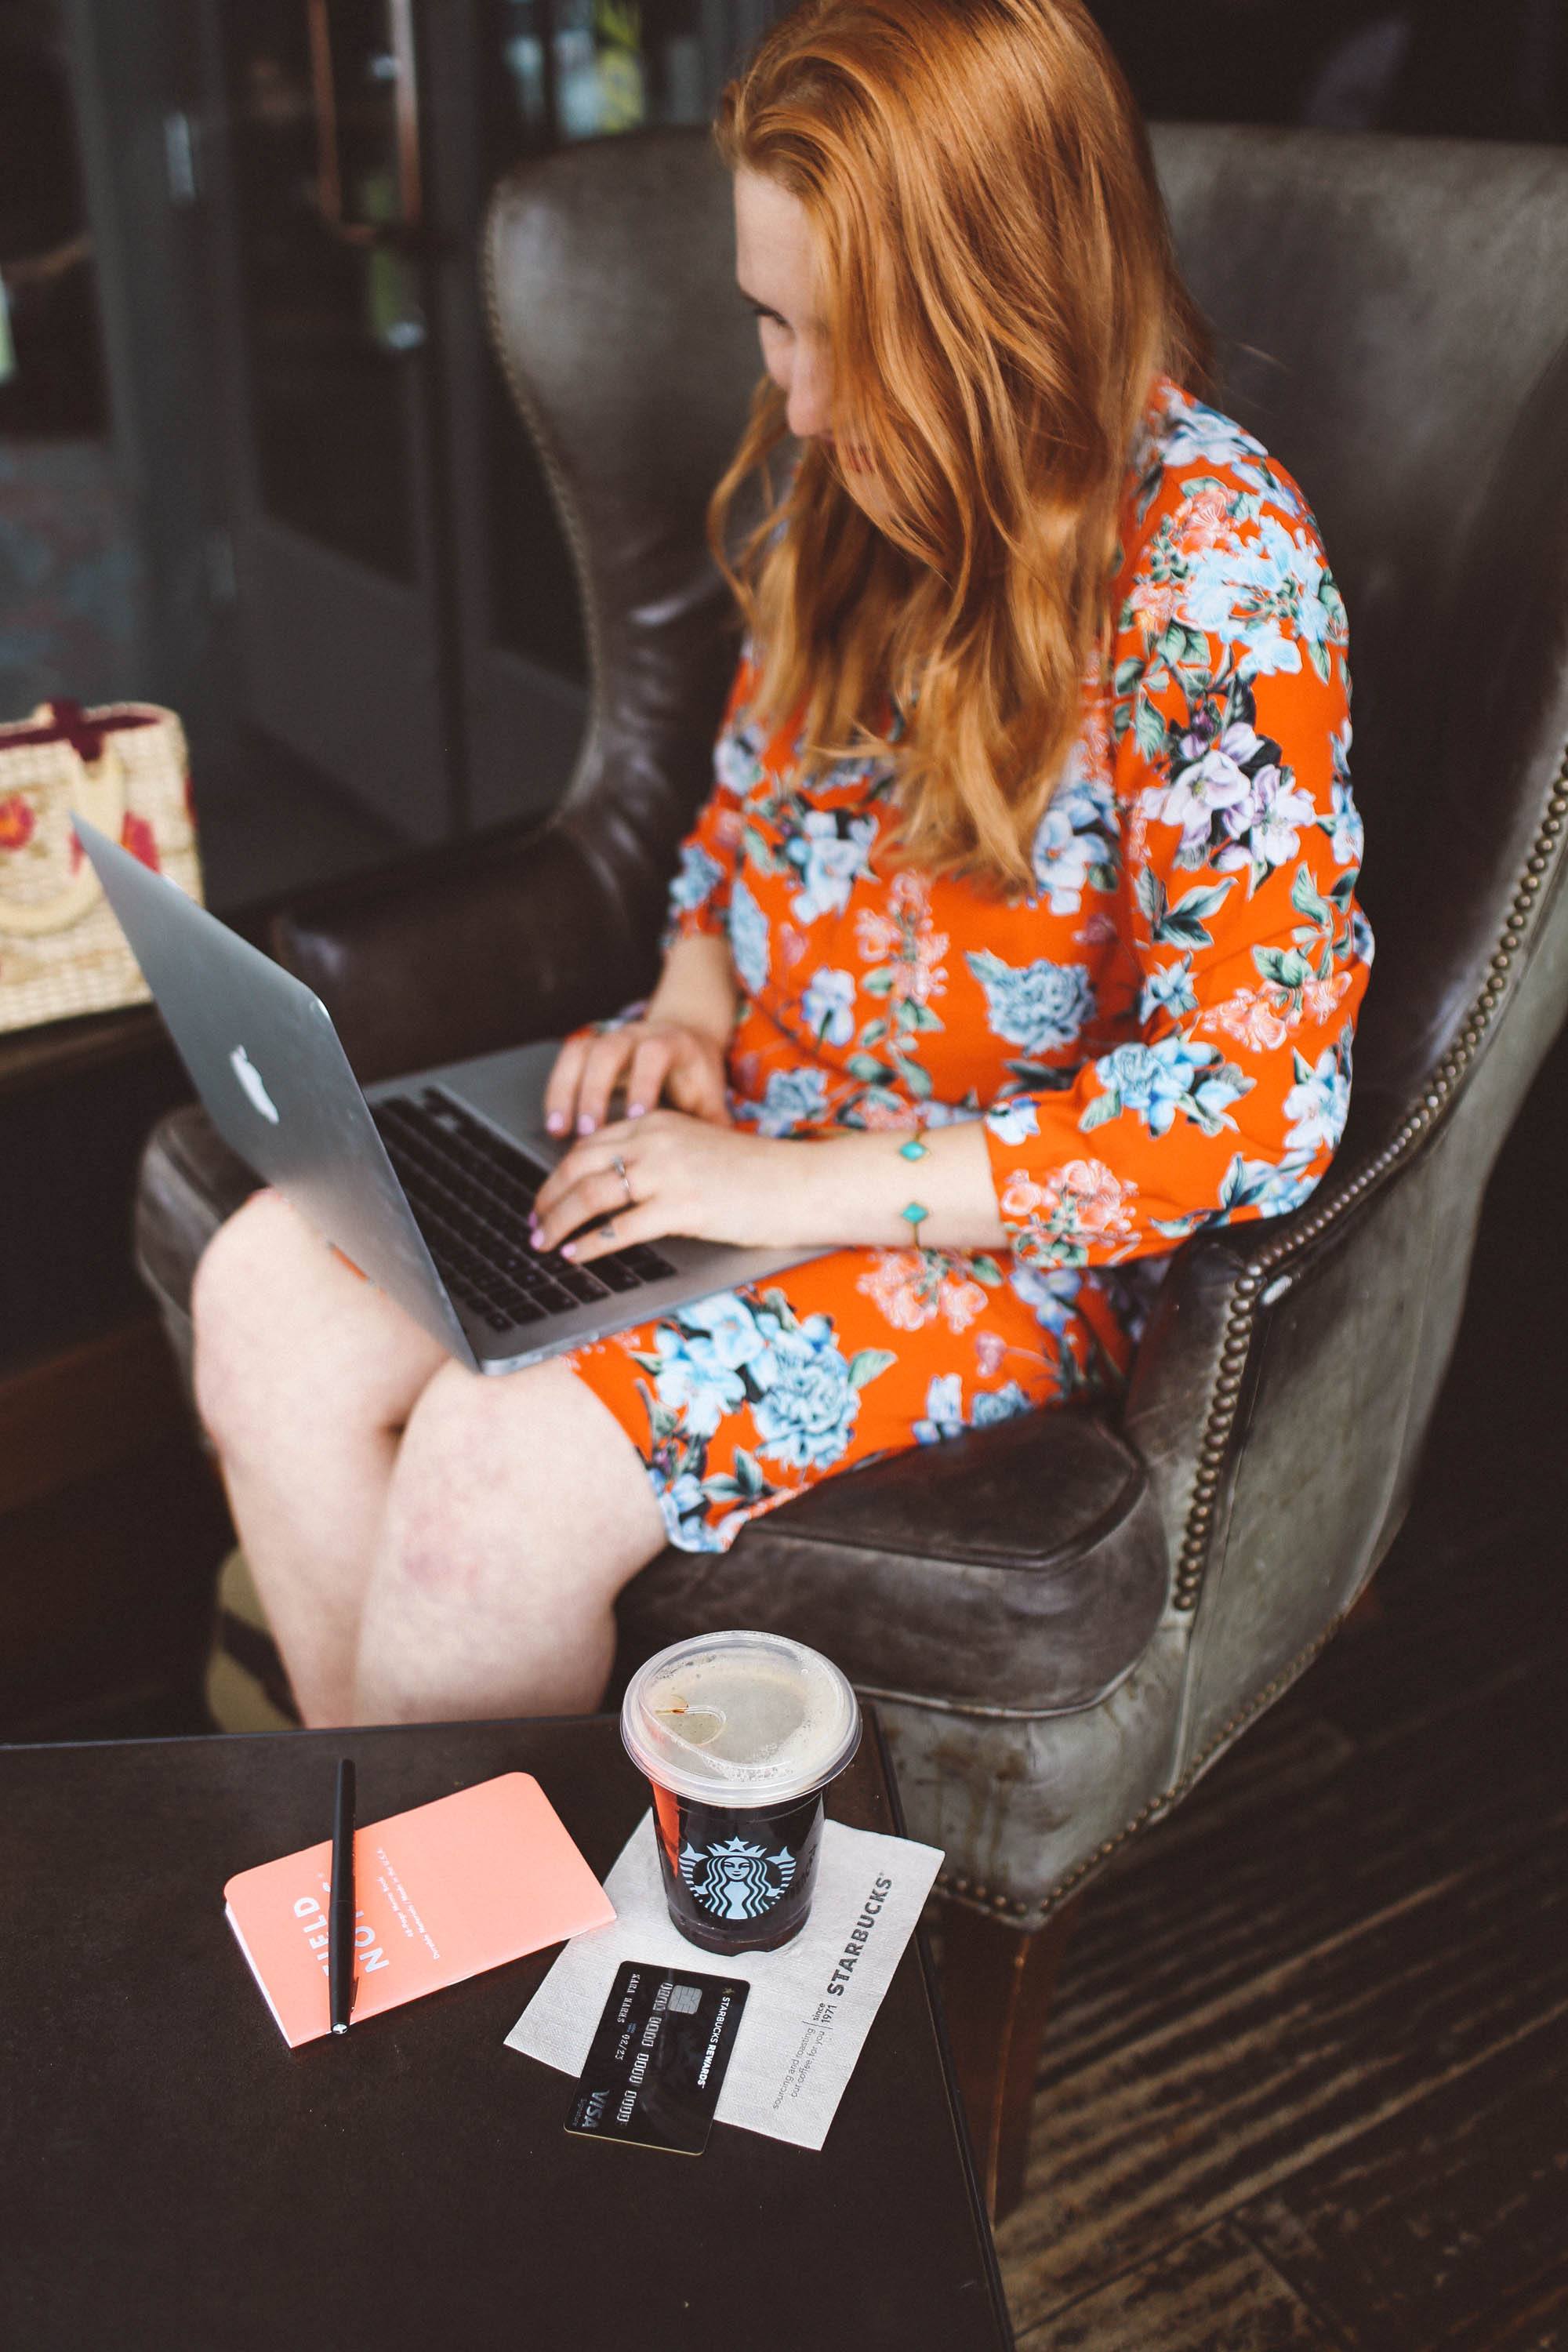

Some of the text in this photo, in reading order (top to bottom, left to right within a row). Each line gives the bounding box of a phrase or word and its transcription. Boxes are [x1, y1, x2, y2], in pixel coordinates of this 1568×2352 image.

[376, 1875, 390, 1893] Book
[396, 1883, 408, 1902] Made
[388, 1892, 399, 1911] Memo
[407, 1904, 426, 1934] Materials
[424, 1933, 440, 1960] Durable
[827, 1877, 893, 1997] STARBUCKS
[813, 2002, 826, 2021] since
[821, 2005, 837, 2024] 1971
[615, 2034, 630, 2061] 02/23
[697, 1996, 731, 2088] STARBUCKS REWARDS
[773, 2027, 816, 2110] sourcing and roasting
[791, 2084, 800, 2098] our
[806, 2046, 818, 2057] for
[815, 2030, 826, 2045] you
[582, 2089, 610, 2129] VISA
